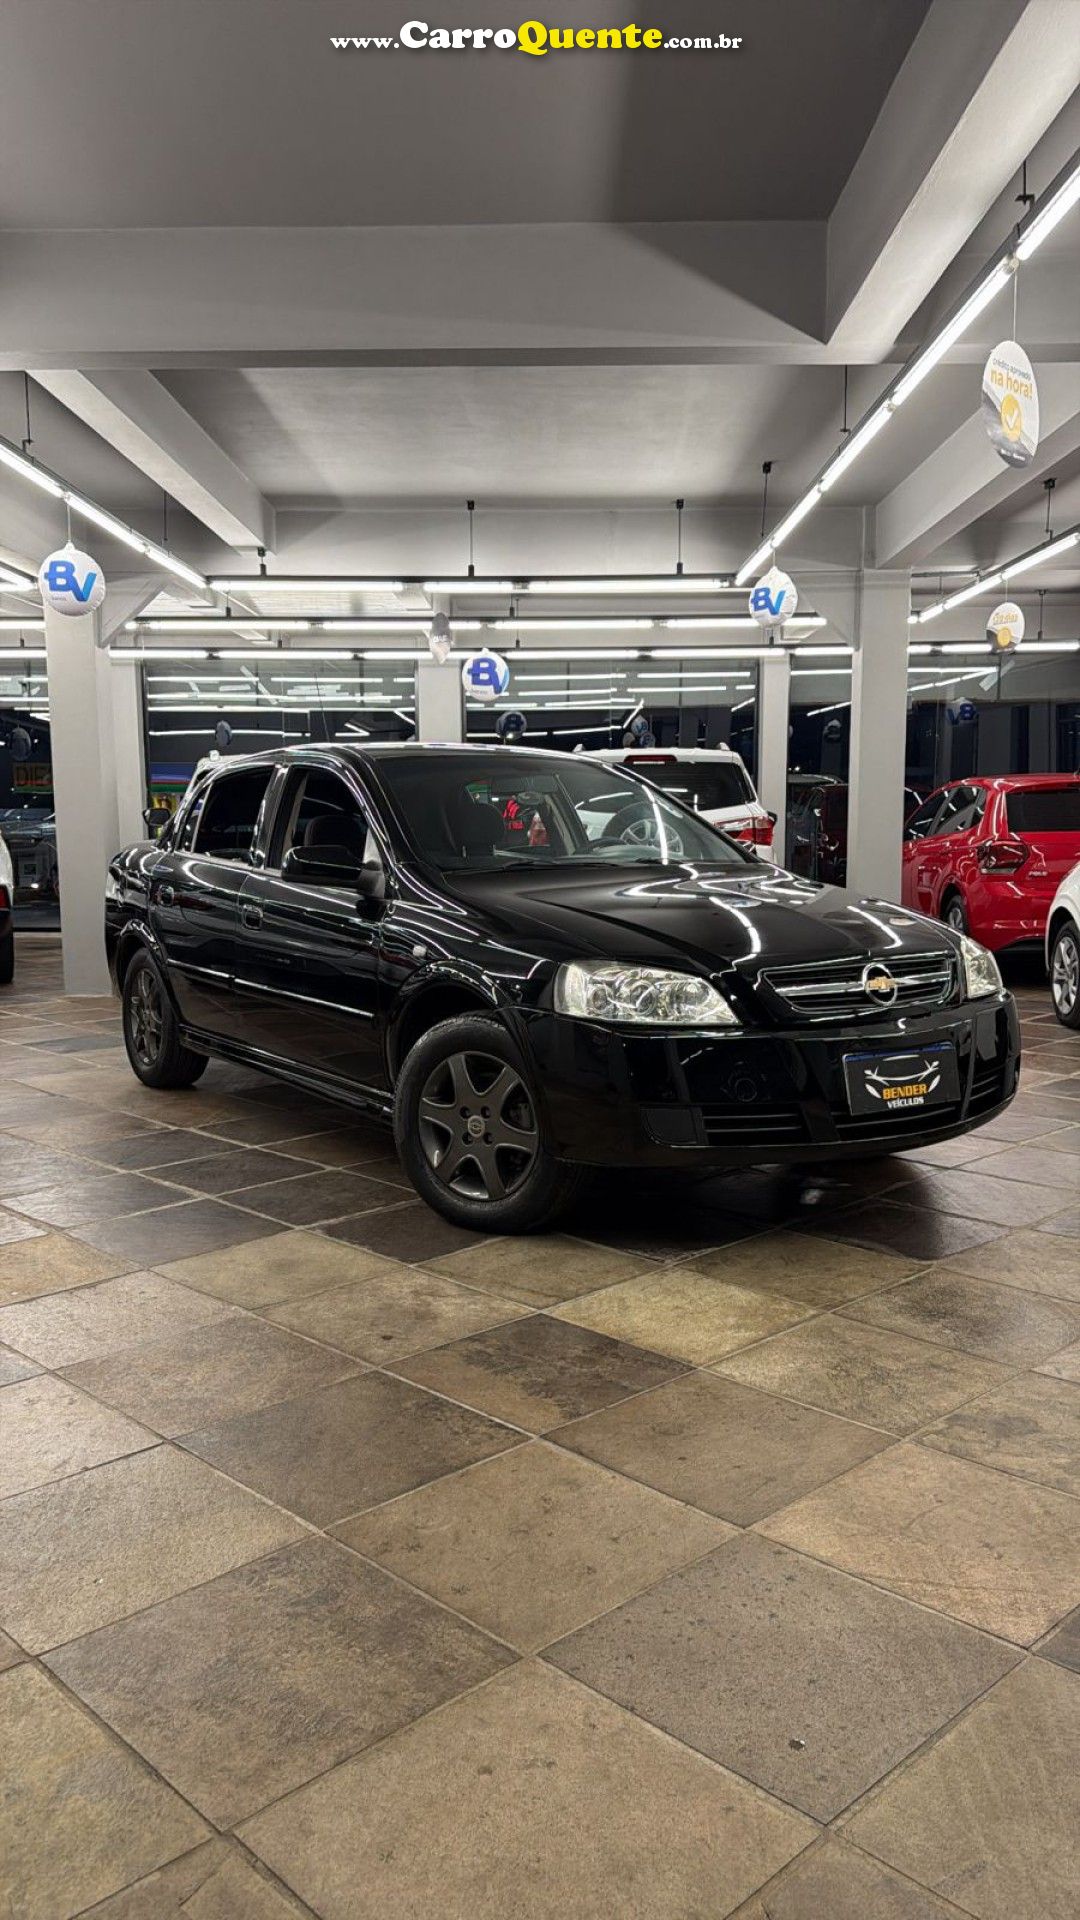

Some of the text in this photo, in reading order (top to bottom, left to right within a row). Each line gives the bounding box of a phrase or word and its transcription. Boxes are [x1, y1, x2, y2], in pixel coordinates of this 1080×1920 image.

[990, 369, 1033, 399] na hora!
[44, 560, 97, 602] BV
[751, 587, 786, 616] BV
[882, 1083, 928, 1100] BENDER
[887, 1096, 925, 1109] VEÍCULOS
